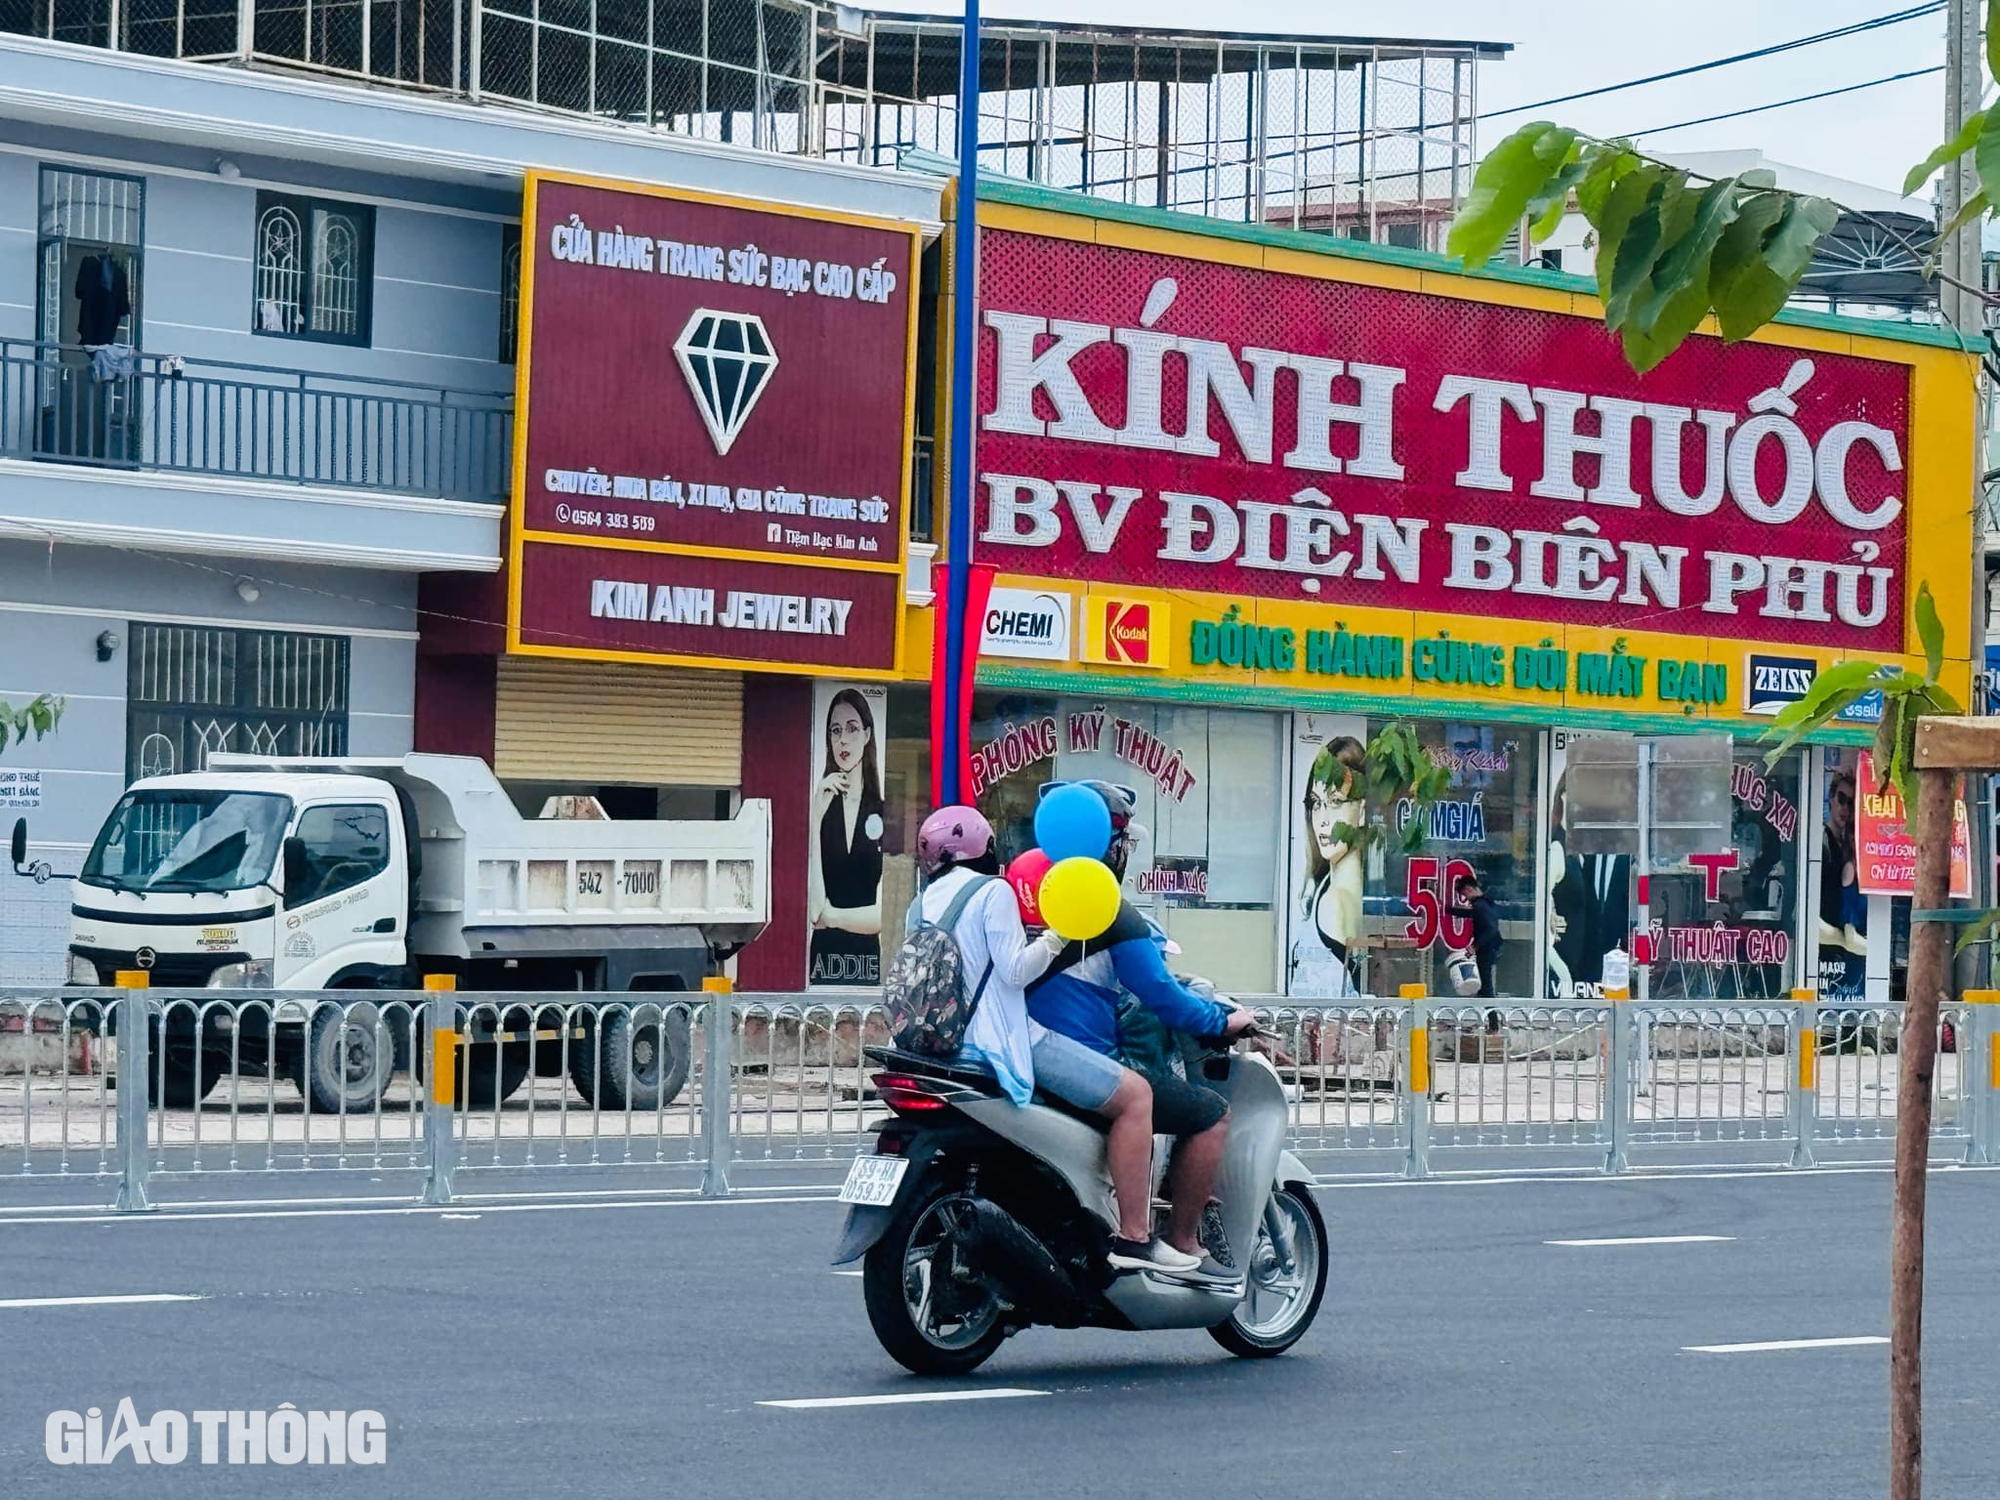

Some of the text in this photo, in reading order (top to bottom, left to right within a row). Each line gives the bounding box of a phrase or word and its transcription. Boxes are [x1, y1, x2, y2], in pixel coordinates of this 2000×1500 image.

[551, 213, 896, 304] CỬA HÀNG TRANG SỨC BẠC CAO CẤP
[982, 277, 1903, 530] KÍNH THUỐC
[764, 486, 806, 515] CÔNG
[808, 495, 857, 520] TRANG
[859, 495, 889, 523] SỨC
[979, 472, 1894, 628] BV ĐIỆN BIÊN PHỦ
[590, 579, 853, 635] KIM ANH JEWELRY
[986, 609, 1054, 639] CHEMI
[1116, 624, 1148, 642] Kodak
[1191, 603, 1727, 716] ĐỒNG HÀNH CÙNG ĐÔI MẮT BẠN
[1755, 666, 1812, 694] ZEISS
[970, 704, 1196, 804] PHÒNG KỸ THUẬT
[810, 953, 880, 981] ADDIE
[1668, 920, 1741, 969] THUẬT
[1746, 930, 1788, 965] CAO
